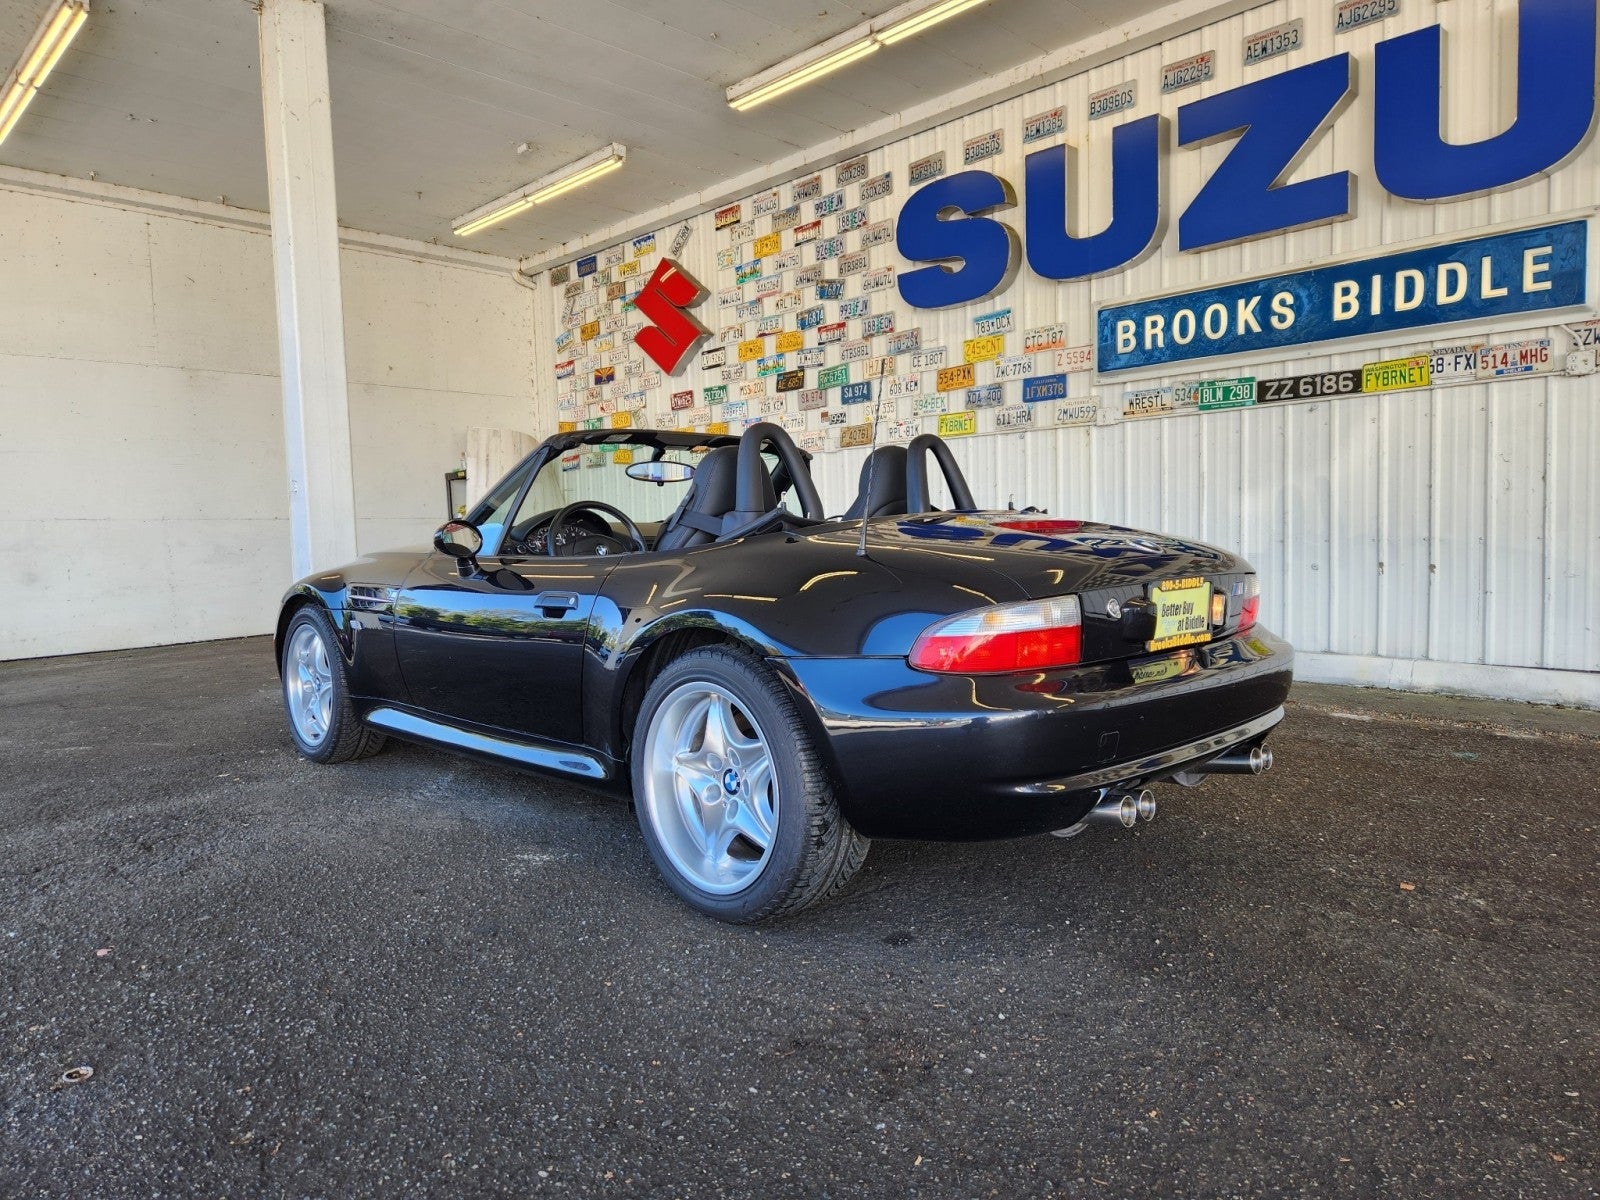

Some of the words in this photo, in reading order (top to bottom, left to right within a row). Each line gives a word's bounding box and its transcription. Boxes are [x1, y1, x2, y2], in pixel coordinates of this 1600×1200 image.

[1245, 29, 1299, 61] AEW1353
[1247, 30, 1280, 44] WASHINGTON
[1162, 62, 1211, 90] AJG2295
[1090, 89, 1133, 115] B30960S
[1115, 291, 1296, 355] BROOKS
[1332, 245, 1554, 322] BIDDLE
[1025, 334, 1043, 349] CTC
[1046, 330, 1064, 344] 187
[1066, 349, 1092, 365] 5594
[1431, 346, 1467, 356] NEVADA
[1481, 352, 1509, 370] 514
[1519, 347, 1549, 365] MHG
[912, 356, 922, 368] CE
[924, 352, 943, 367] 1807
[1365, 362, 1407, 373] WASHINGTON
[1214, 379, 1239, 387] Vermont
[1365, 366, 1425, 389] FYBRNET
[844, 388, 853, 398] SA
[854, 385, 867, 396] 974
[1230, 384, 1250, 400] 298
[1265, 380, 1294, 400] ZZ
[1300, 372, 1354, 396] 6186
[1128, 394, 1167, 410] WRESTL
[1161, 603, 1182, 618] Better
[1182, 601, 1195, 615] Buy
[1177, 619, 1184, 631] at
[1184, 616, 1205, 630] Biddle
